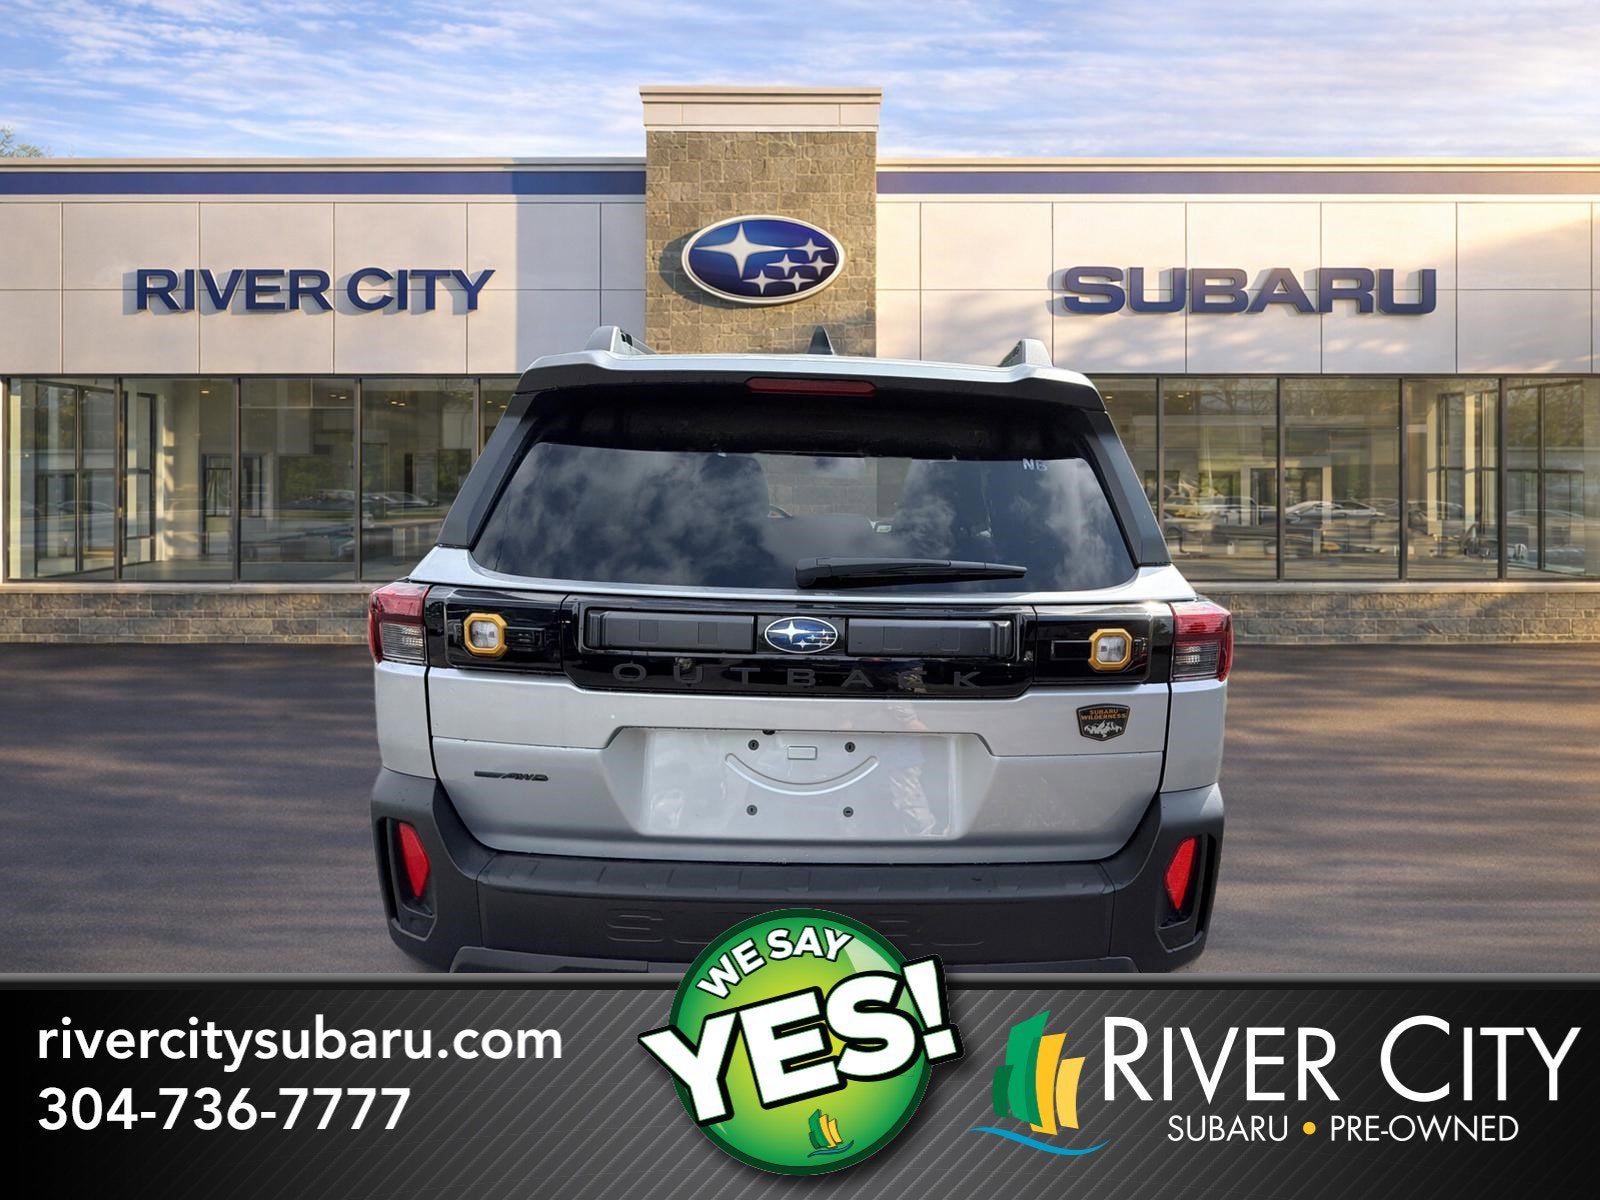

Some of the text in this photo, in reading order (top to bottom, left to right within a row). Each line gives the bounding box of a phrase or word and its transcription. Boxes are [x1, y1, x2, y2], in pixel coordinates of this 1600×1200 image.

[136, 267, 496, 312] RIVER CITY
[1063, 266, 1437, 314] SUBARU
[612, 662, 982, 691] OUTBACK
[1080, 712, 1127, 721] WILDERNESS
[1089, 708, 1119, 716] SUBARU
